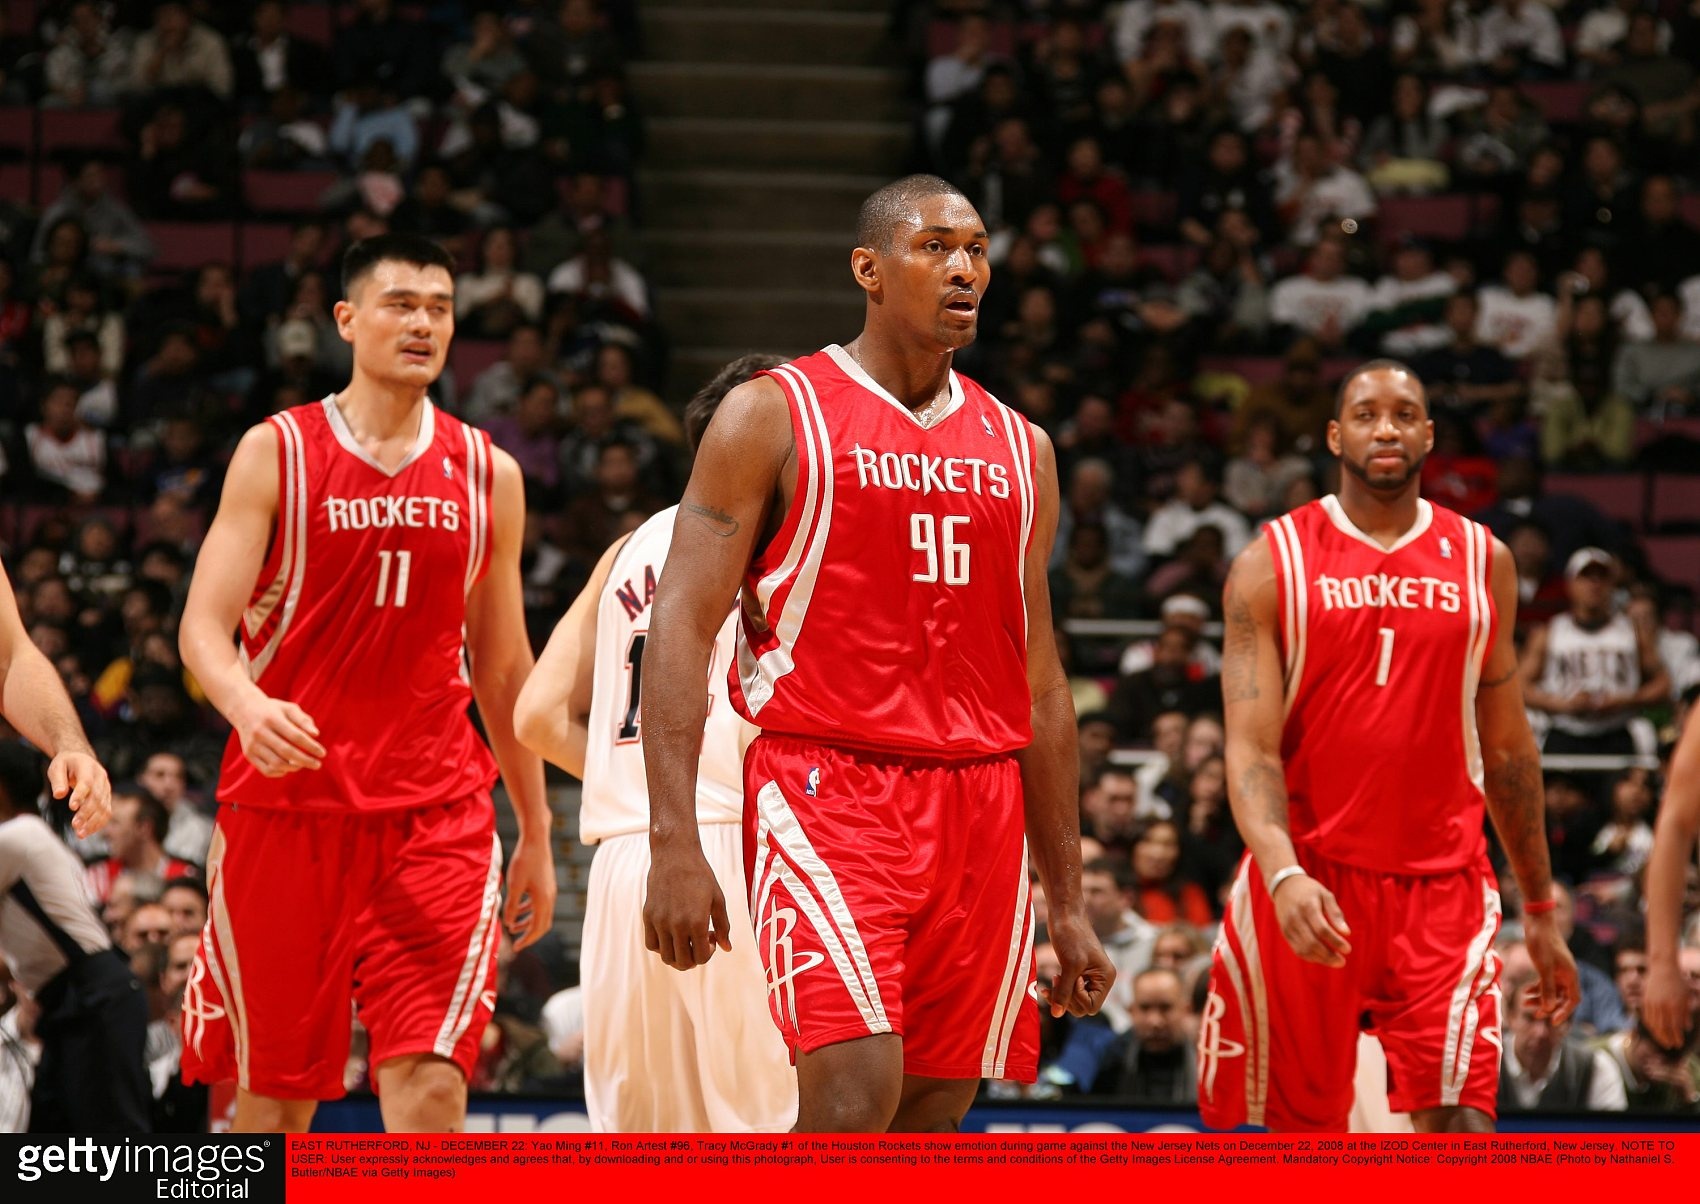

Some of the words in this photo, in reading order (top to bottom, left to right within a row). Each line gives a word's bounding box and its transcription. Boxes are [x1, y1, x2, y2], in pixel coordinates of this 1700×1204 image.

[848, 442, 1010, 500] ROCKETS
[321, 495, 460, 532] ROCKETS
[909, 513, 972, 586] 96
[374, 550, 412, 607] 11
[1314, 573, 1461, 614] ROCKETS
[1375, 627, 1396, 686] 1
